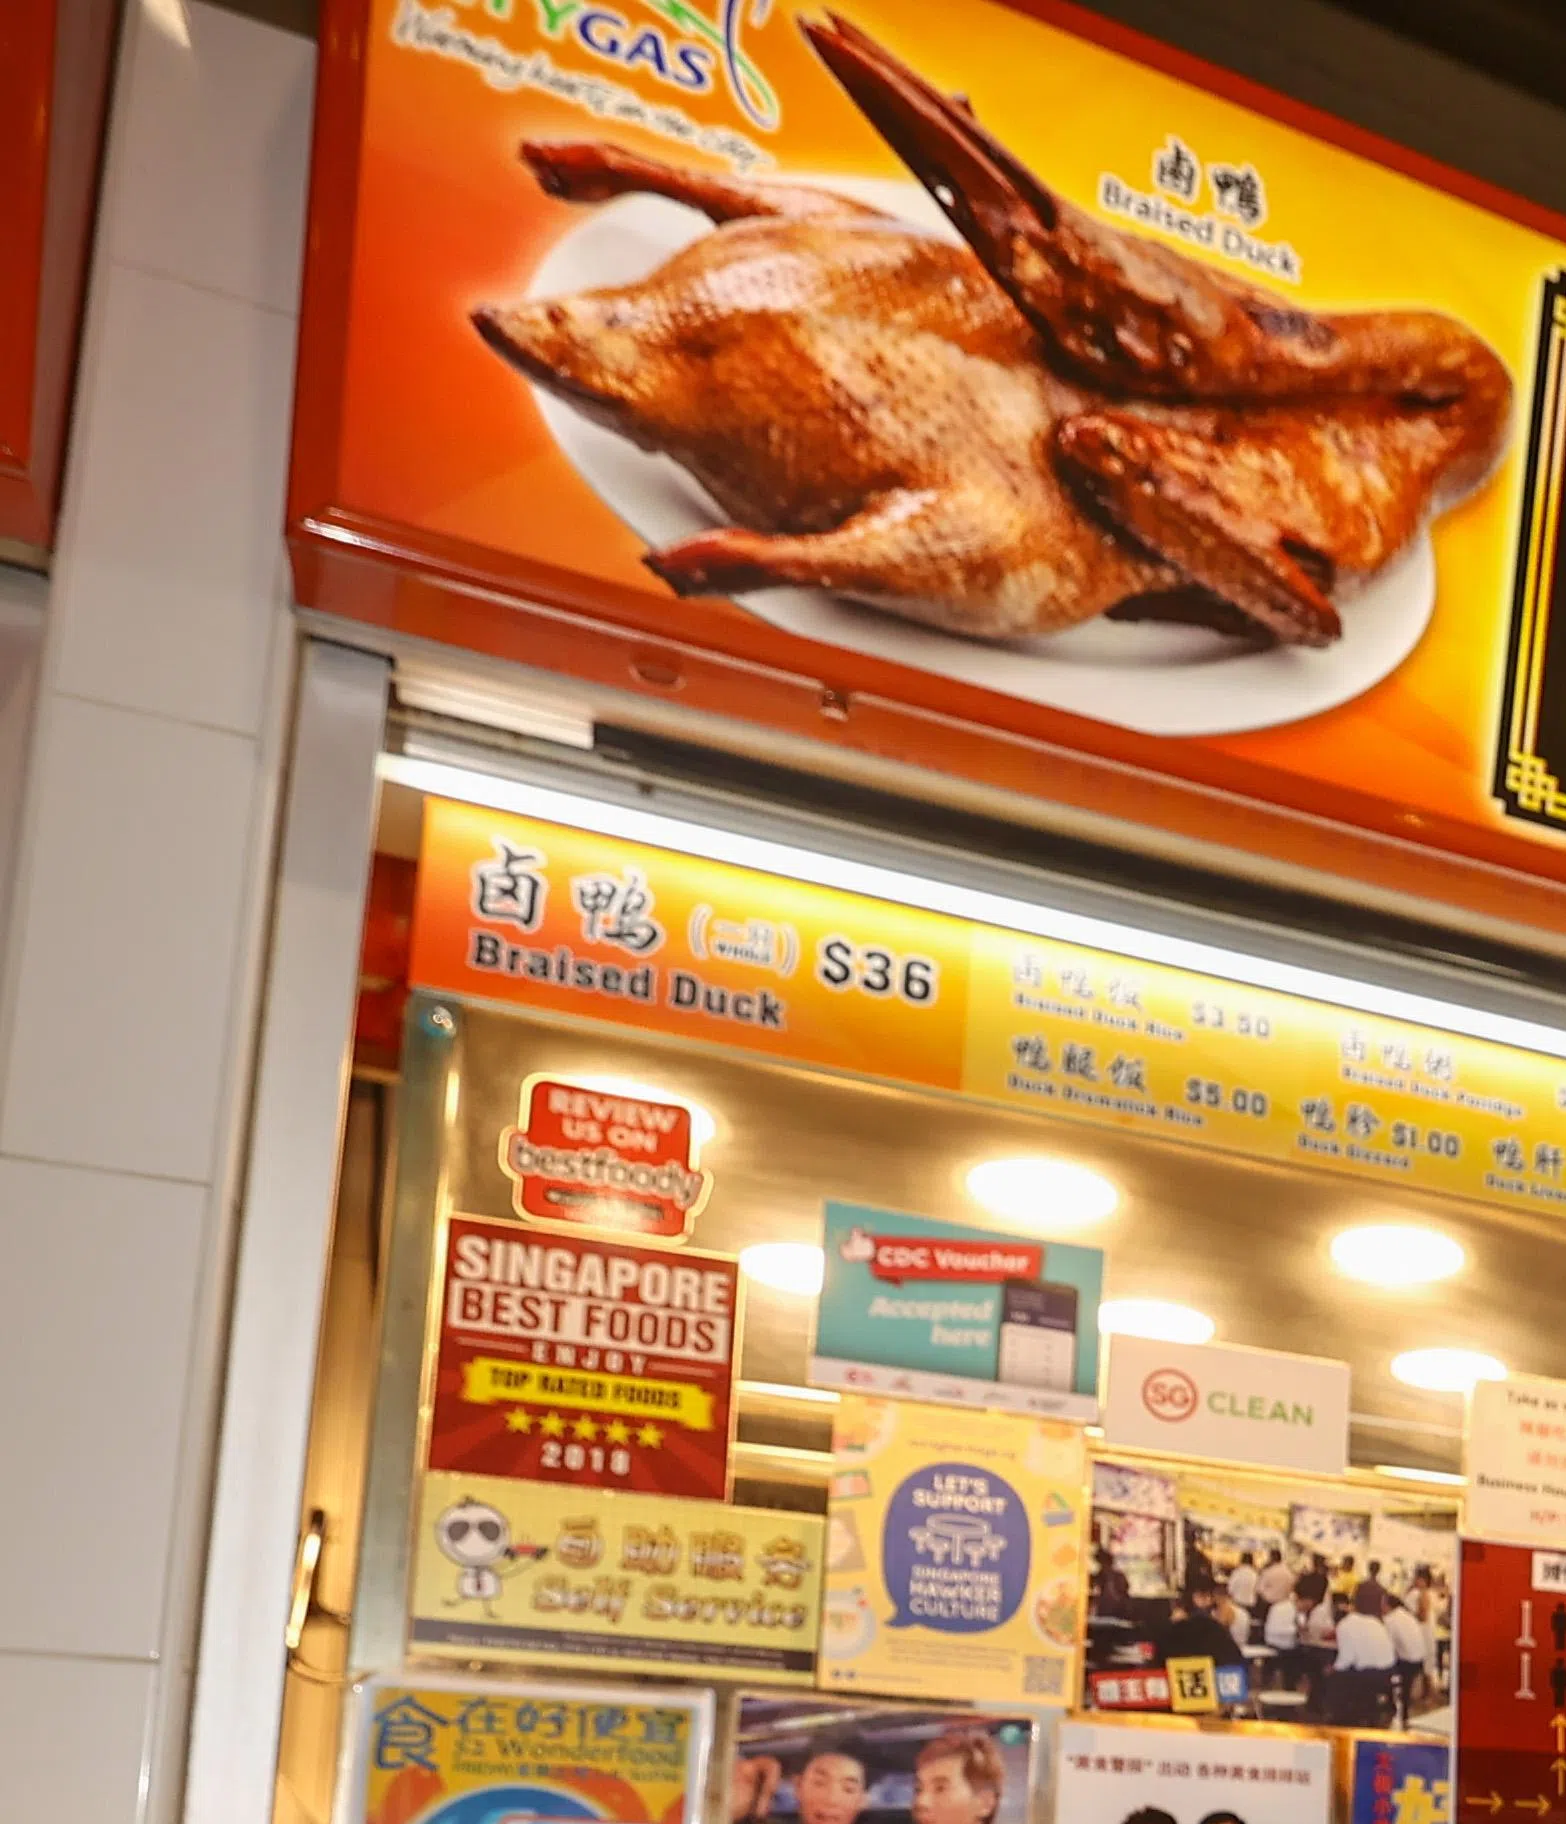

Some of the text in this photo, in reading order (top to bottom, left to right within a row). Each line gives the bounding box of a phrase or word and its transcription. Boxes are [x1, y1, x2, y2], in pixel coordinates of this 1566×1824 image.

[1103, 178, 1296, 275] Braised Duck
[476, 840, 660, 952] 卤鸭
[473, 933, 789, 1030] Braised Duck
[547, 1089, 682, 1136] REVIEW
[454, 1234, 732, 1315] SINGAPORE
[875, 1244, 1030, 1274] CDC Voucher
[459, 1286, 717, 1354] BEST FOODS
[867, 1295, 994, 1326] Accepted
[929, 1322, 992, 1350] here
[530, 1341, 650, 1376] ENJOY
[489, 1365, 683, 1410] TOP RATED FOODS
[1206, 1390, 1315, 1427] CLEAN
[540, 1441, 631, 1476] 2018
[912, 1488, 1008, 1515] SUPPORT
[933, 1474, 990, 1495] LET'S
[531, 1572, 808, 1631] Self Service
[909, 1580, 1002, 1602] HAWKER
[908, 1599, 999, 1622] CULTURE
